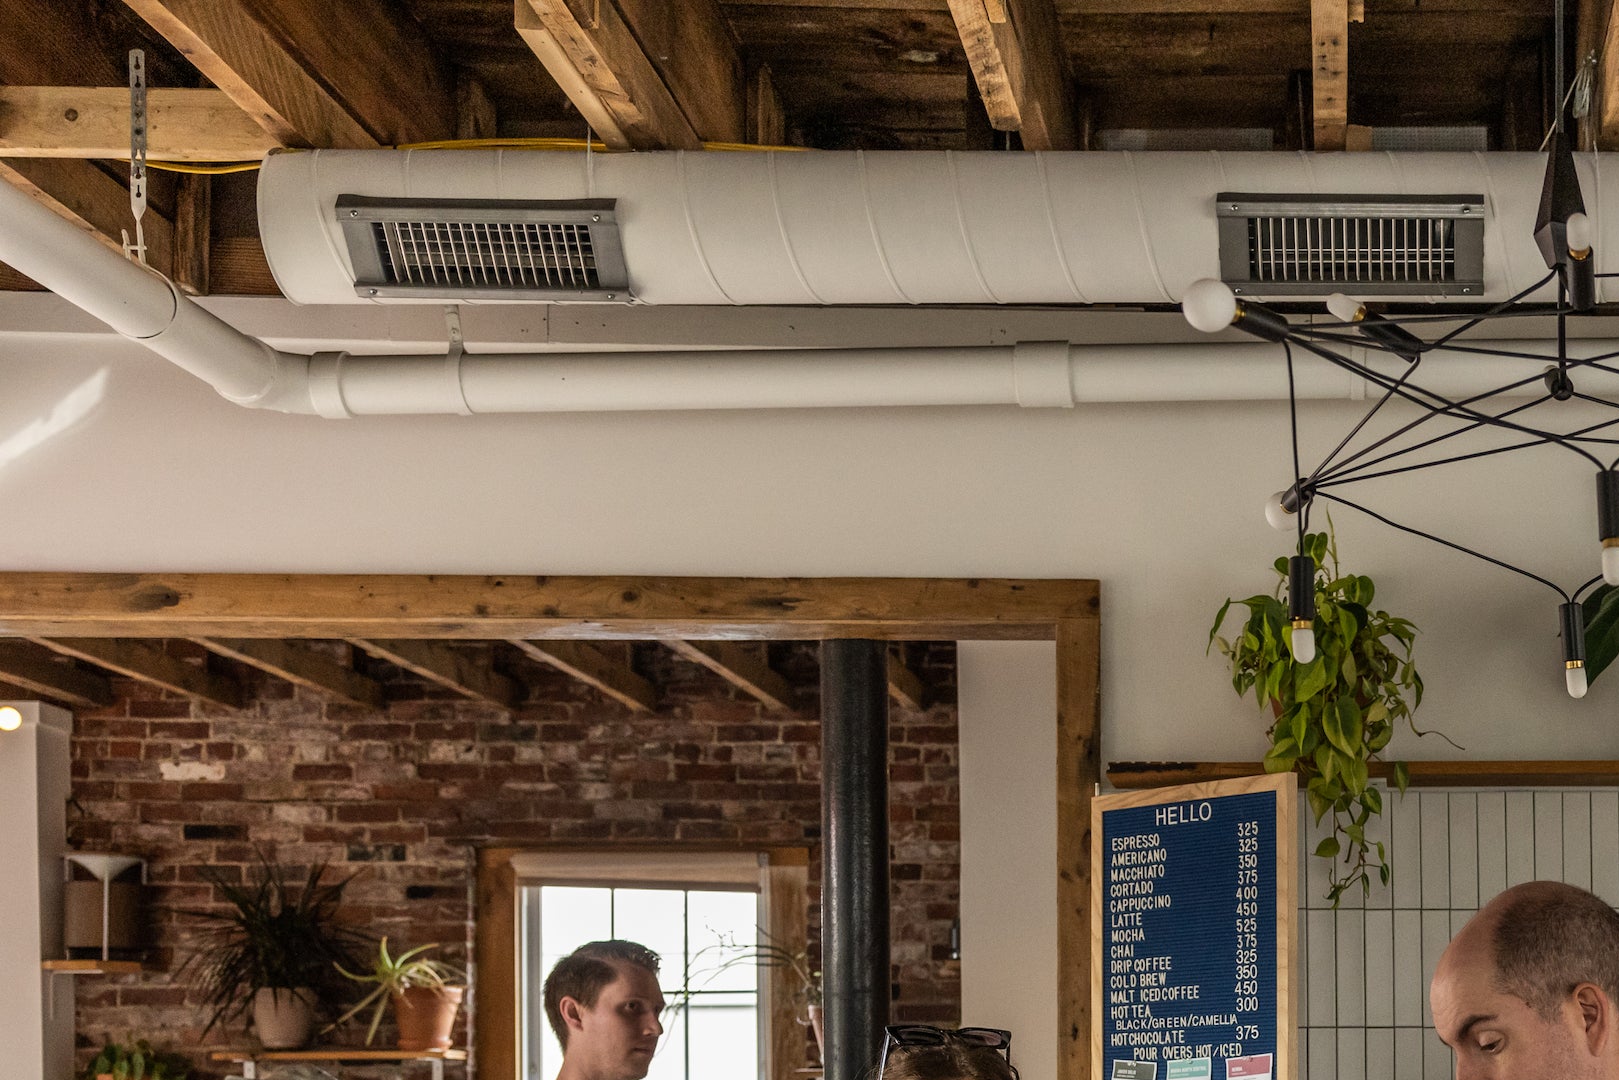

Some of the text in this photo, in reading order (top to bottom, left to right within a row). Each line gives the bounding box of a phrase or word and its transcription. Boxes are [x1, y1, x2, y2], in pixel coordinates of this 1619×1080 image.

[1156, 802, 1212, 826] HELLO
[1112, 821, 1258, 851] ESPRESSO 325
[1112, 838, 1258, 866] AMERICANO 325
[1111, 854, 1257, 882] MACCHIATO 350
[1110, 870, 1258, 897] CORTADO 375
[1110, 886, 1257, 912] CAPPUCCINO 400
[1112, 902, 1257, 928] LATTE 450
[1112, 918, 1257, 943] MOCHA 525
[1111, 934, 1257, 959] CHAI 375
[1111, 949, 1257, 974] DRIP COFFEE 325
[1111, 965, 1257, 989] COLD BREW 350
[1111, 981, 1257, 1004] MALT ICED COFFEE 450
[1111, 997, 1258, 1020] HOT TEA 300
[1111, 1025, 1259, 1046] HOT CHOCOLATE 375
[1134, 1043, 1242, 1061] POUR OVERS HOT/ICED
